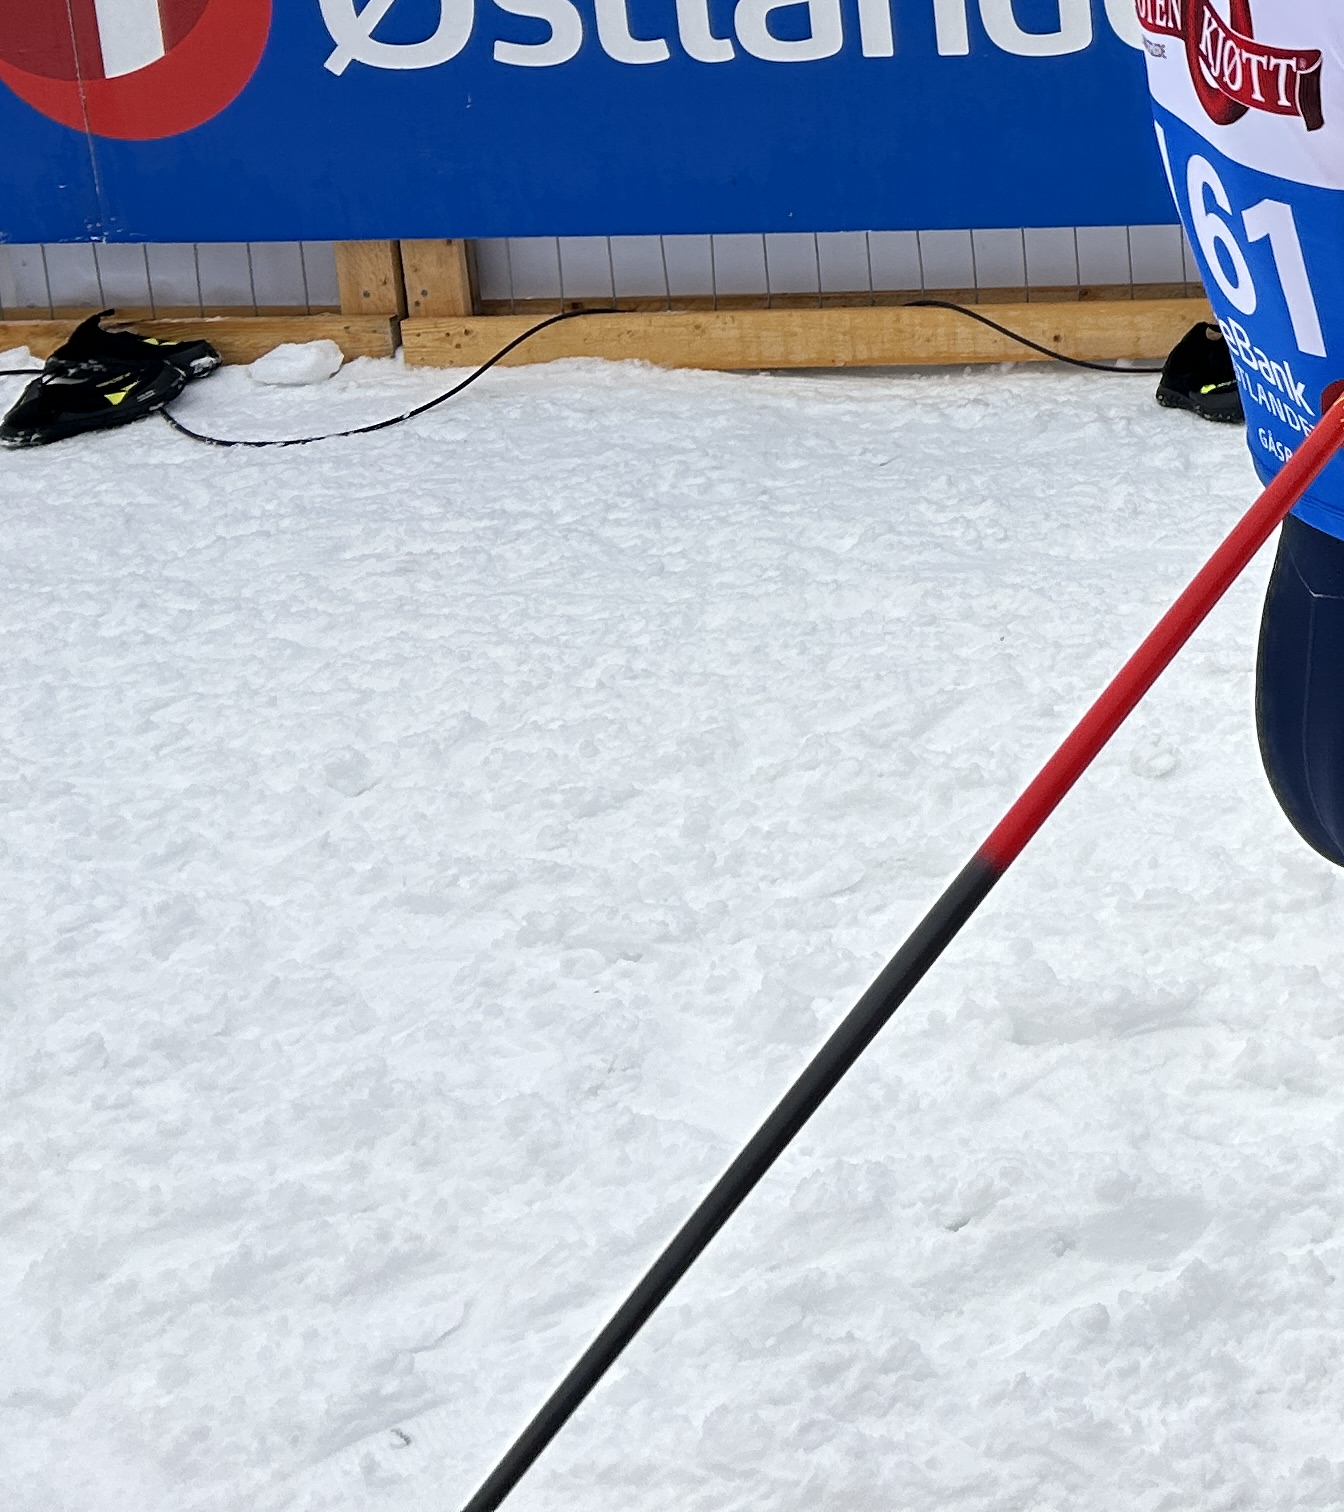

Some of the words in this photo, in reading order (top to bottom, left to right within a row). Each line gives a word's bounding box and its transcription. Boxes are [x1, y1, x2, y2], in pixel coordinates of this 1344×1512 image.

[1199, 5, 1298, 109] KJØTT
[1186, 153, 1328, 358] 61
[1217, 316, 1316, 417] eBank
